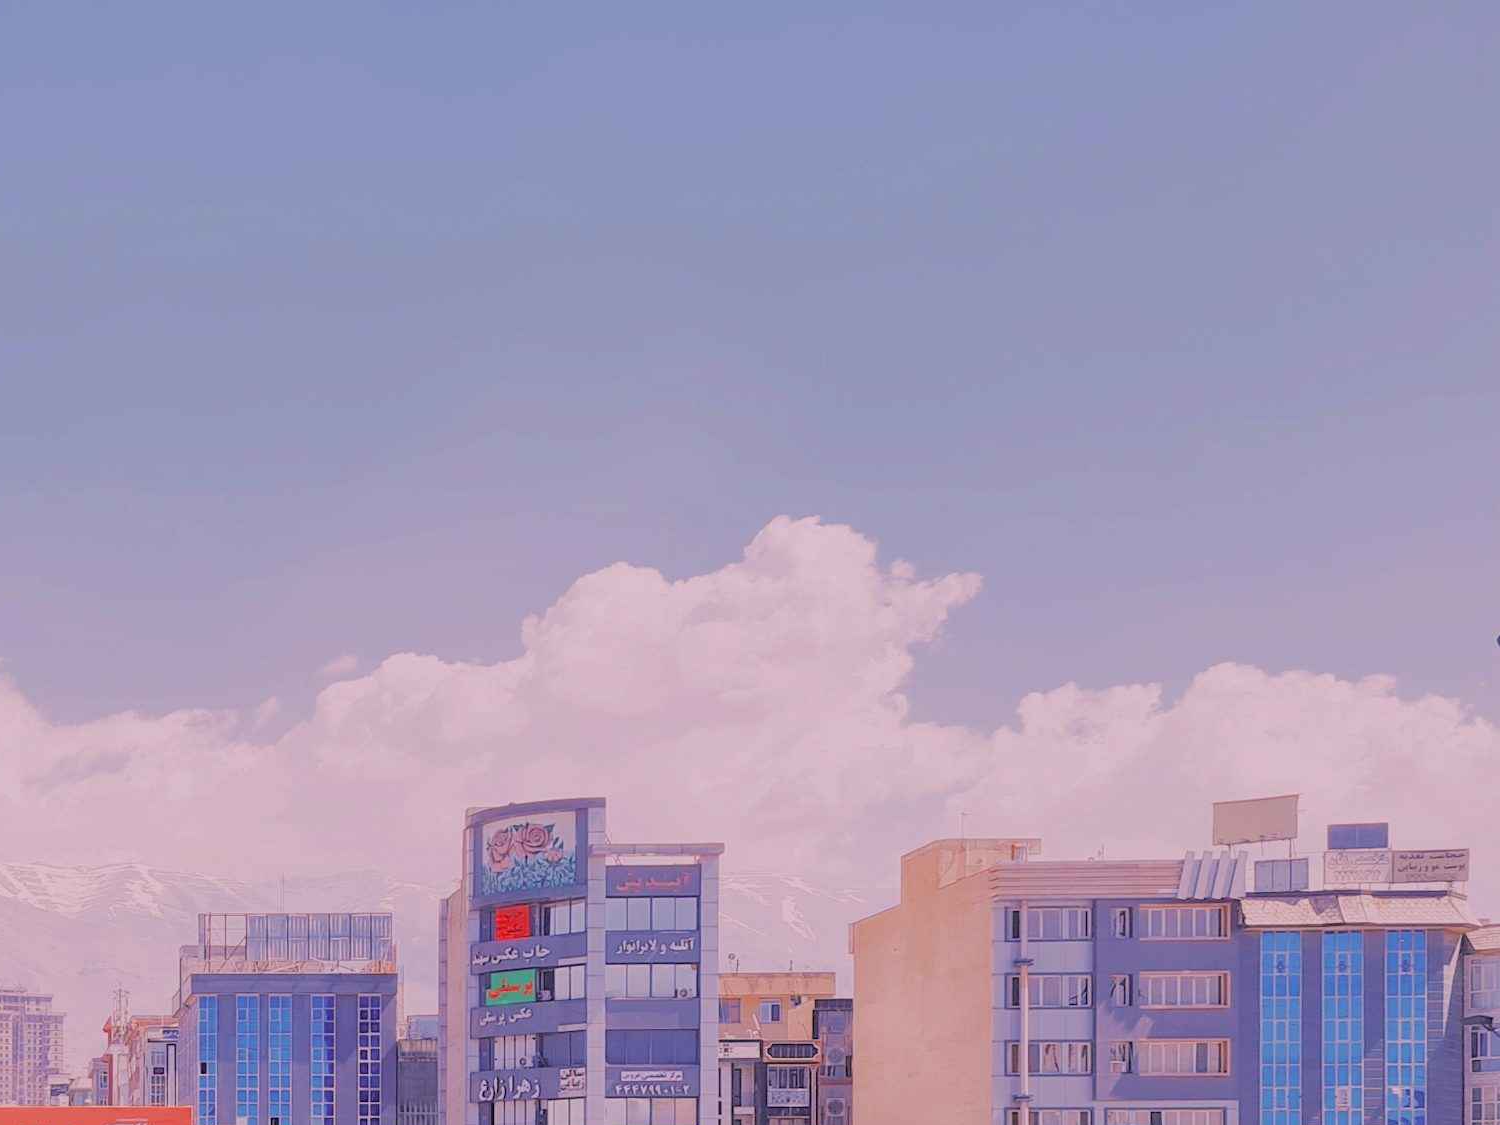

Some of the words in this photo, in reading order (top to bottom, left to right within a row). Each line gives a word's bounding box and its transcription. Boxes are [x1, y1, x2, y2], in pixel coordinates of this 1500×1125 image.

[491, 947, 519, 963] عکس
[523, 944, 550, 962] چاپ
[509, 1007, 533, 1023] عکس
[509, 1076, 541, 1099] زهرا
